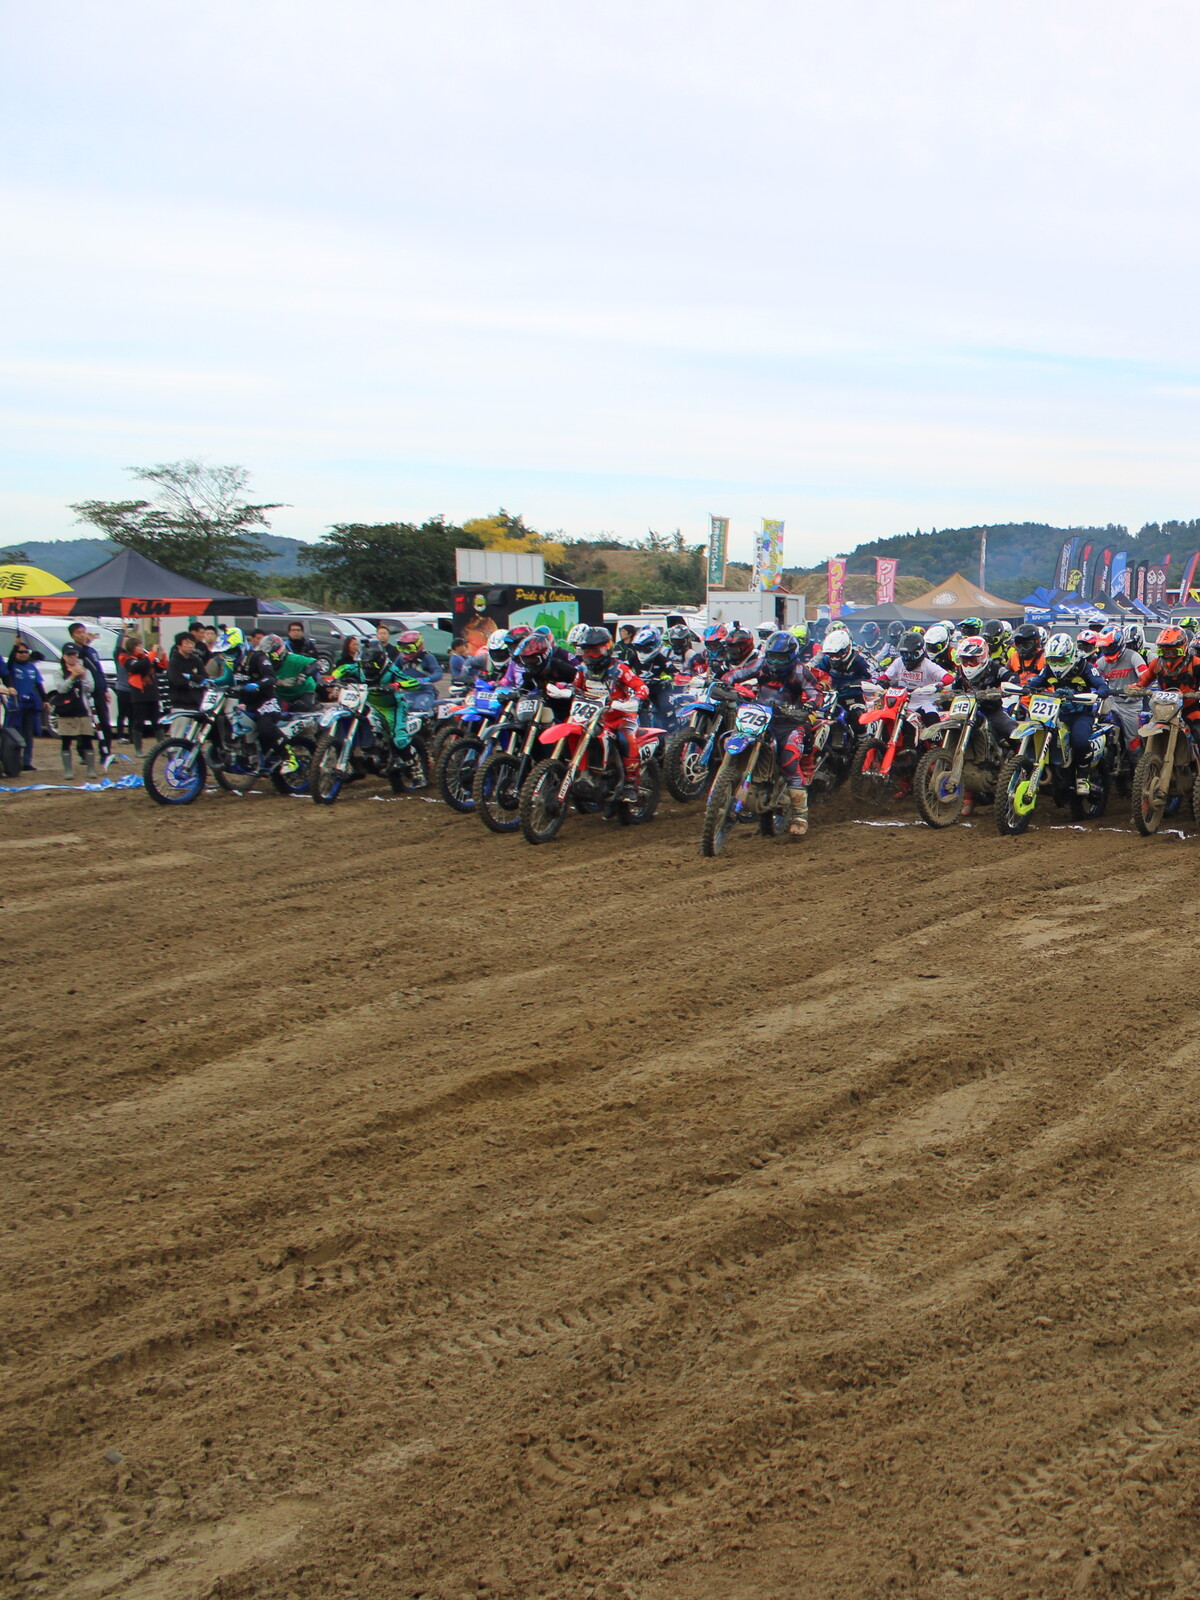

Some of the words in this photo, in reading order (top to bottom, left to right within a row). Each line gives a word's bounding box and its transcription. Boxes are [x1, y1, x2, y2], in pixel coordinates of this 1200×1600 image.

[515, 588, 538, 600] Pride
[539, 590, 547, 604] of
[7, 598, 42, 614] KTM
[129, 599, 172, 615] KTM
[1157, 692, 1176, 701] 222
[952, 702, 969, 713] 242
[742, 711, 768, 727] 219
